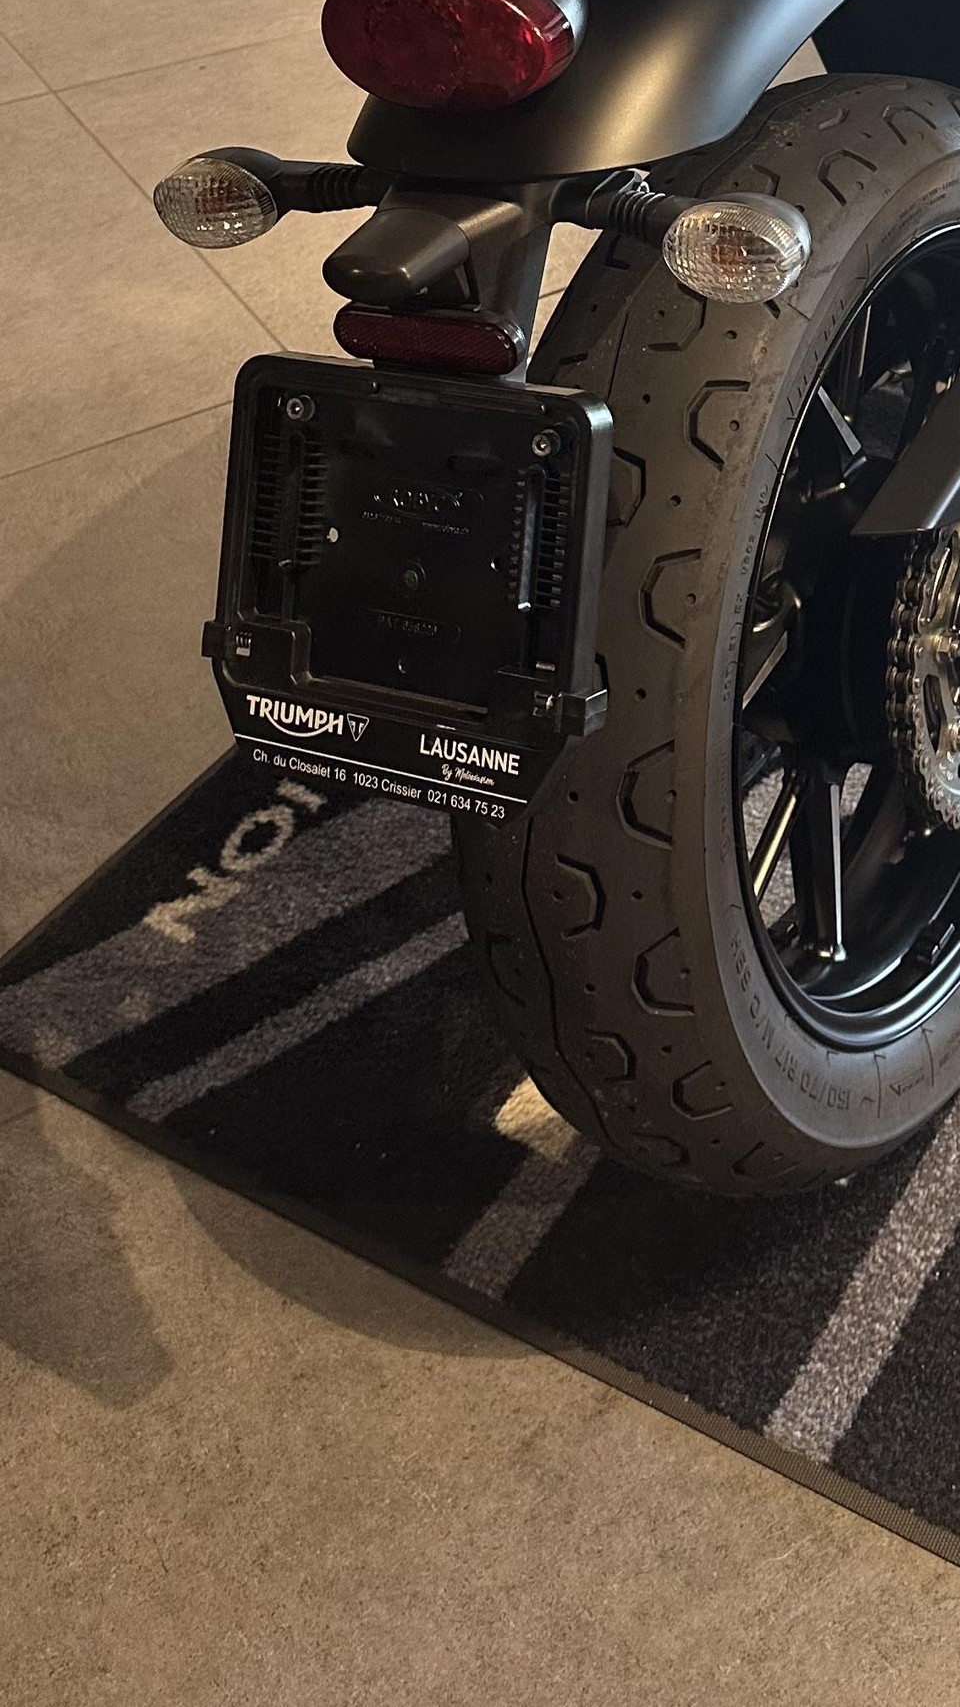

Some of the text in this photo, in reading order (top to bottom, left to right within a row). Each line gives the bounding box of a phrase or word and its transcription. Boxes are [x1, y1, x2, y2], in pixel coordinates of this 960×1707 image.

[246, 694, 520, 775] TRIUMPH LAUSANNE
[253, 749, 505, 820] Ch. du Closalet 16 1023 Crissier 021 634 75 23
